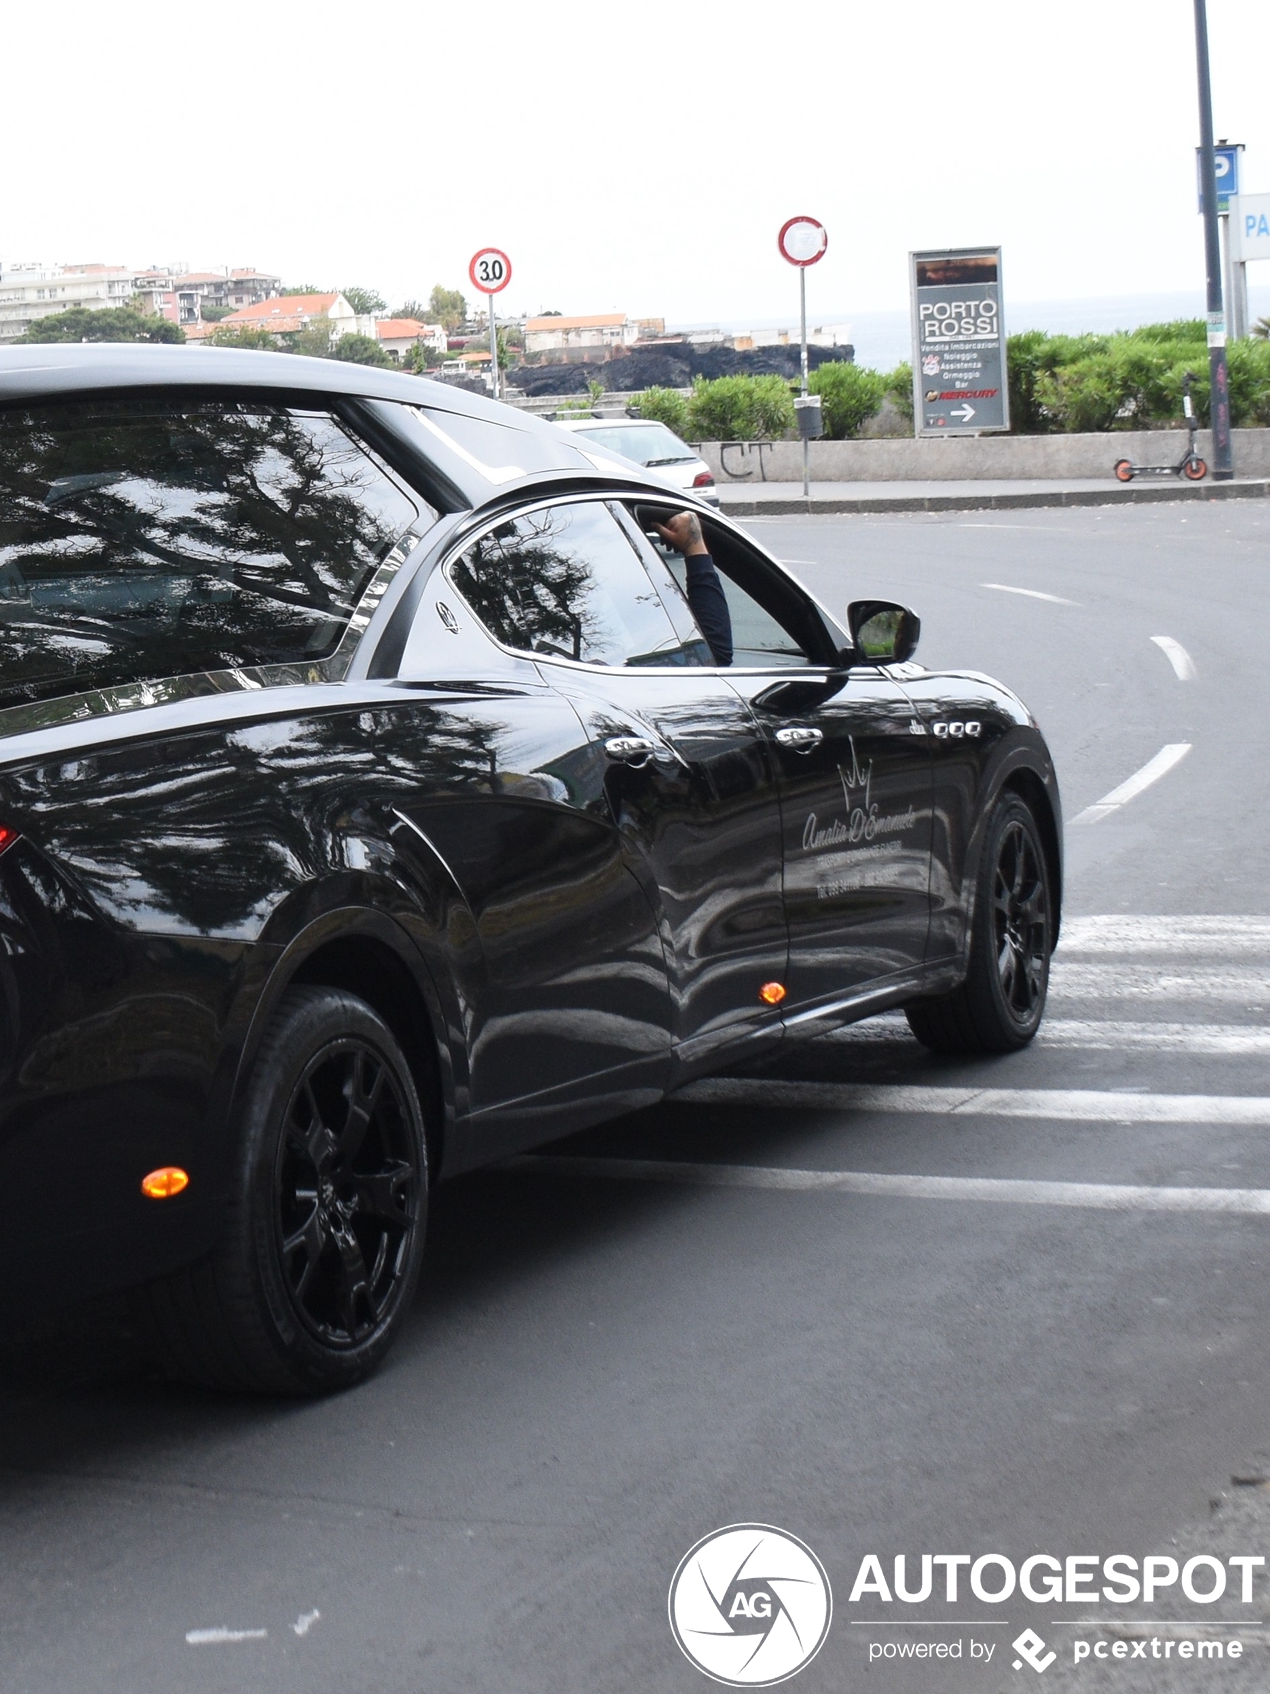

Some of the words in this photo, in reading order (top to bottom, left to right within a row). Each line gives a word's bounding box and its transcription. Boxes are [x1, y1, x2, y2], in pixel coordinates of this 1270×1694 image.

[479, 259, 503, 282] 30
[919, 300, 998, 320] PORTO
[925, 317, 998, 336] ROSSI
[920, 342, 949, 352] Vendita
[950, 341, 999, 351] Imbarcazioni
[943, 352, 978, 361] Noleggio
[940, 361, 982, 370] Assistenza
[942, 371, 980, 380] Ormeggio
[939, 389, 998, 400] MERCURY
